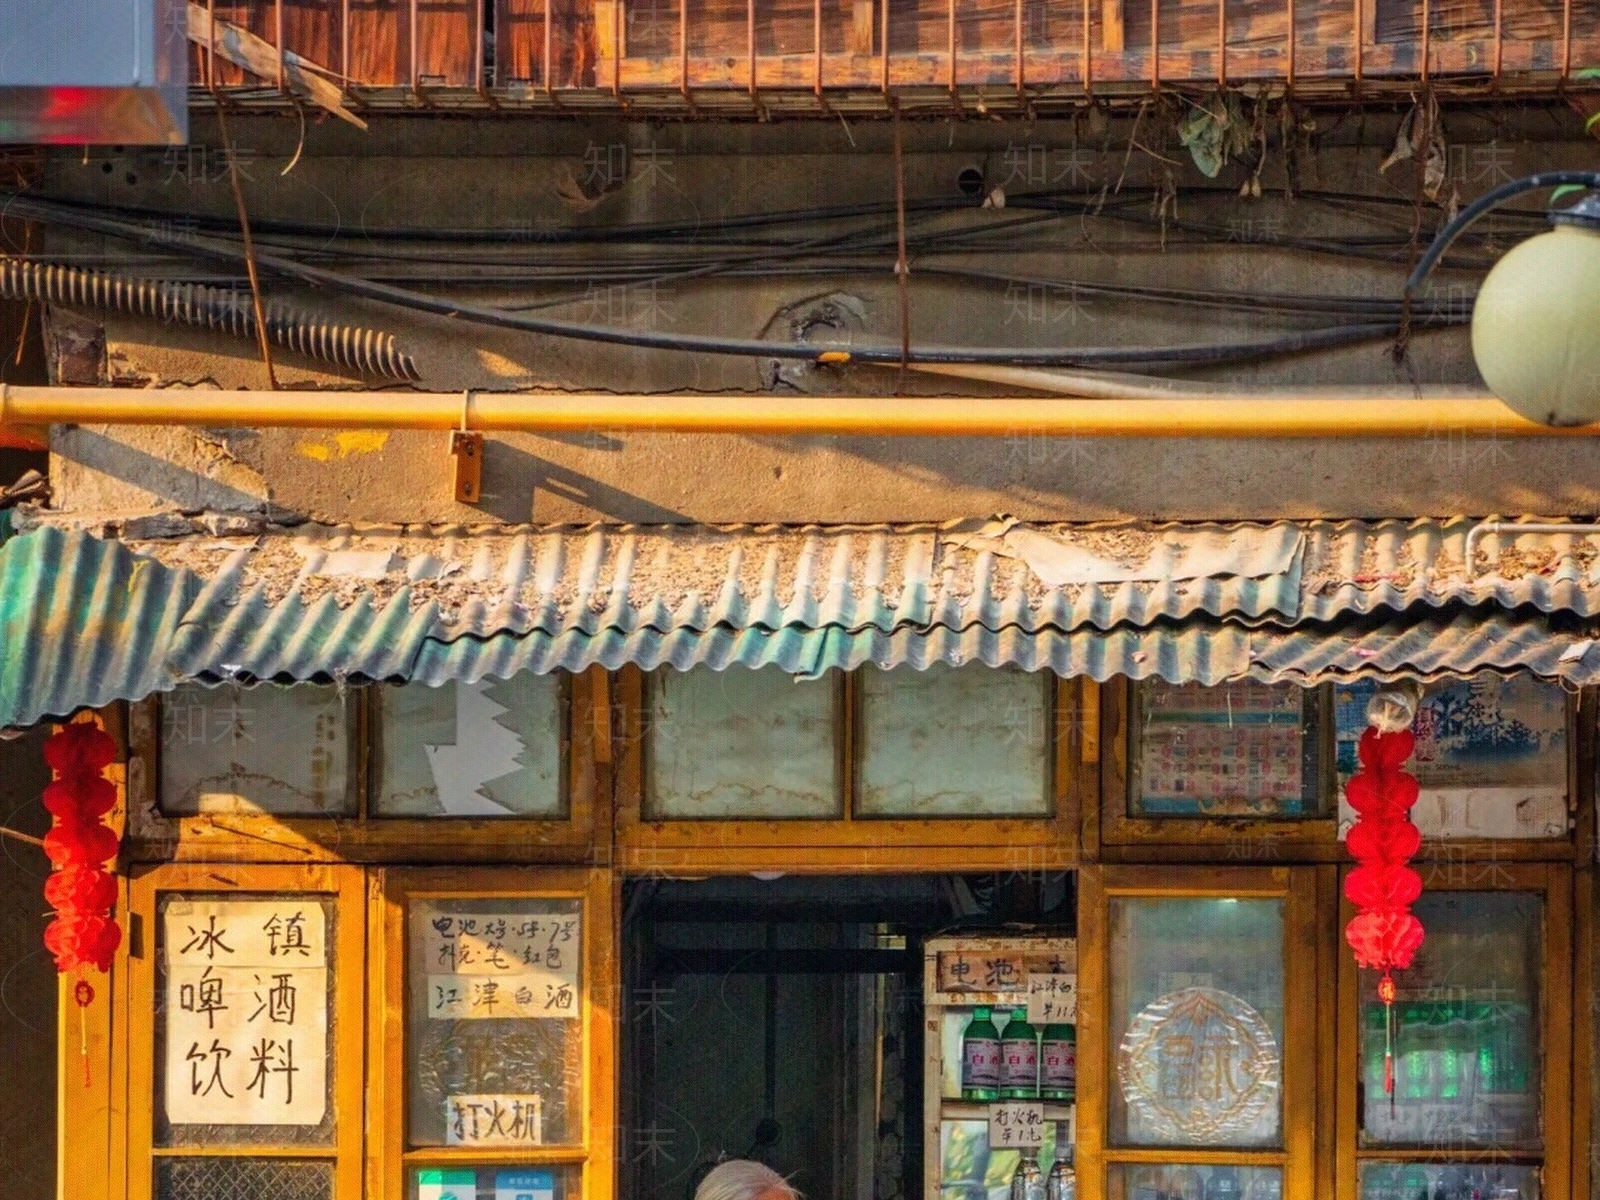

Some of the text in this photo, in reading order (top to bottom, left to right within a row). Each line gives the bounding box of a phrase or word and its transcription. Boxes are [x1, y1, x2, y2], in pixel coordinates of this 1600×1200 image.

[180, 911, 312, 960] 冰镇
[950, 953, 1020, 986] 电池
[1030, 977, 1077, 998] 江津白
[180, 966, 298, 1029] 啤酒
[436, 978, 573, 1014] 江津白酒
[185, 1037, 299, 1104] 饮料
[452, 1100, 535, 1140] 打火机
[994, 1107, 1043, 1126] 打火机
